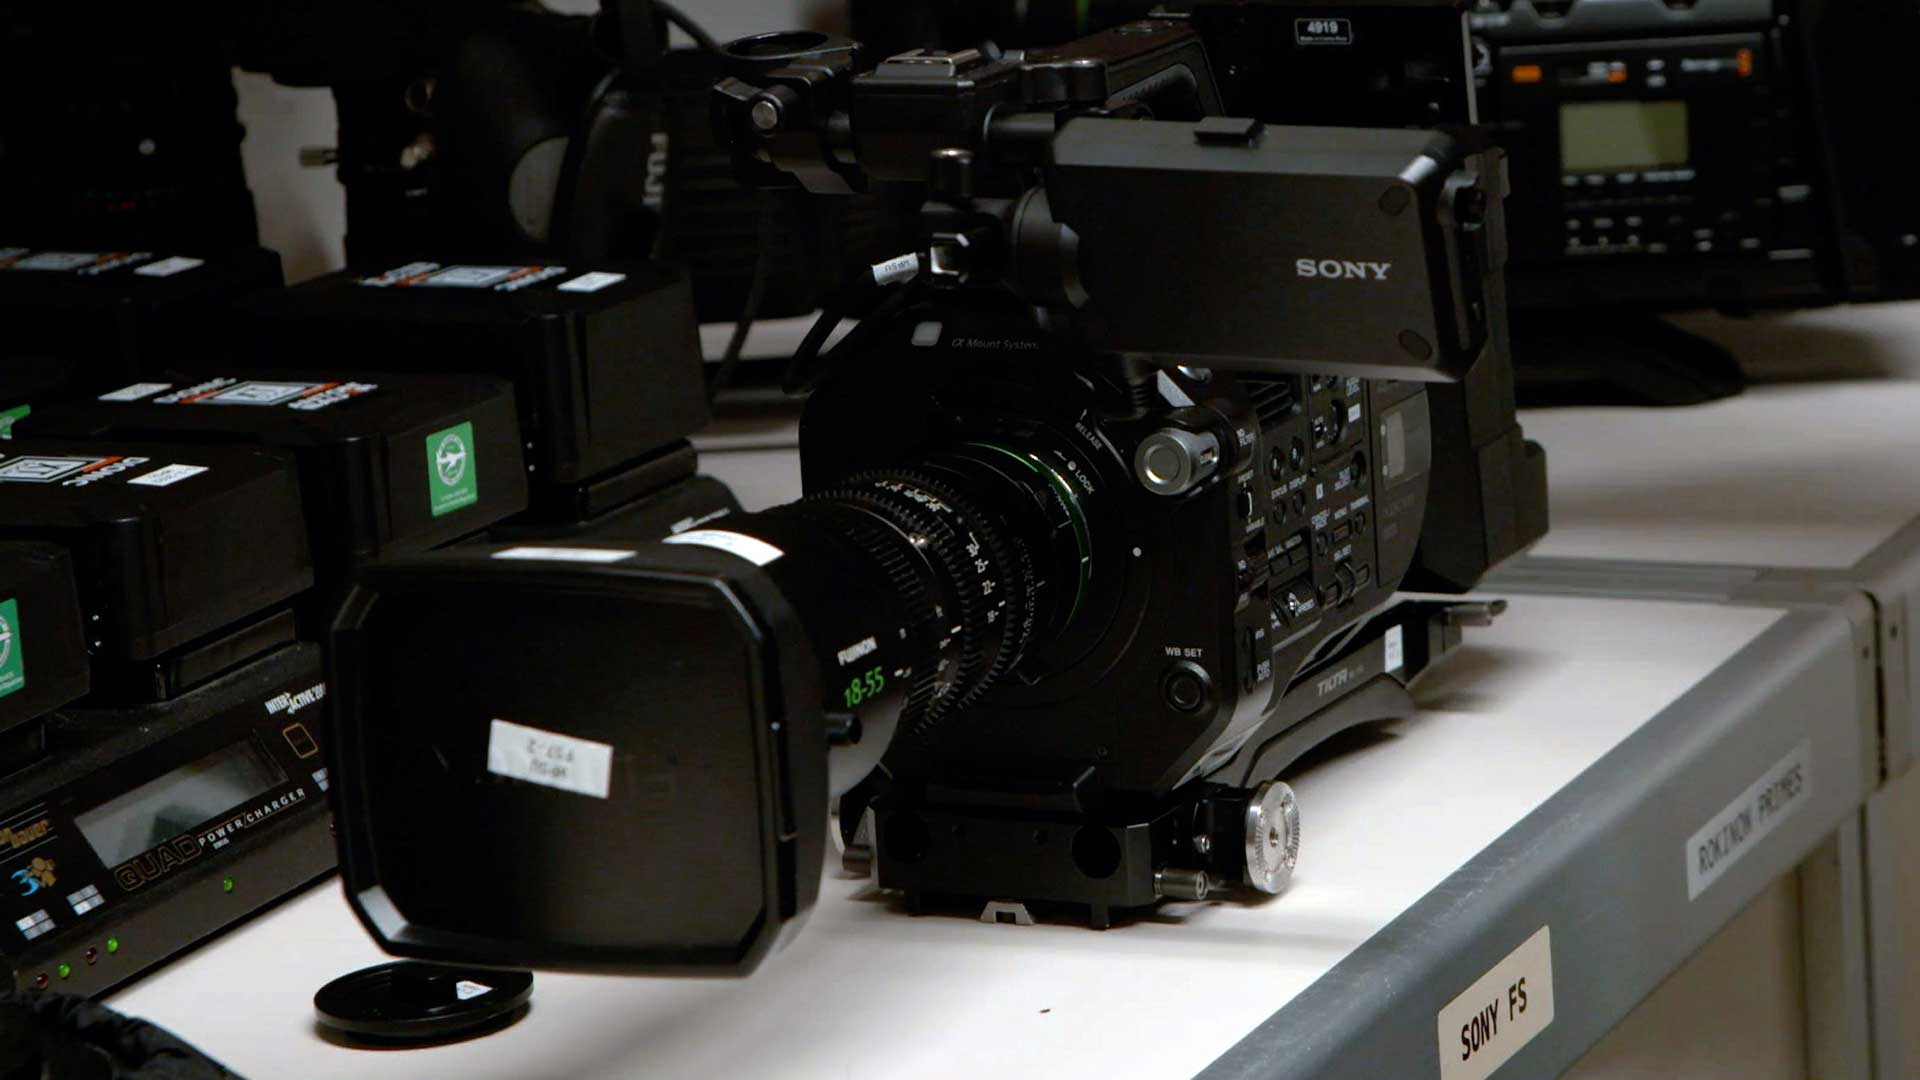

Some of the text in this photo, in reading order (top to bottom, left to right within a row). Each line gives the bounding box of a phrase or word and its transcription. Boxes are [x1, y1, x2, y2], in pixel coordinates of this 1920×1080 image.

[1307, 20, 1339, 35] 4919
[1295, 258, 1392, 281] SONY
[966, 337, 1002, 350] Mount
[1074, 421, 1104, 452] RELEASE
[1074, 469, 1096, 496] LOCK
[1164, 645, 1203, 659] WB SET
[843, 665, 886, 708] 18-55
[199, 817, 244, 848] POWER
[246, 786, 306, 823] CHARGER
[1699, 808, 1753, 874] ROKINON
[1461, 976, 1528, 1061] SONY FS
